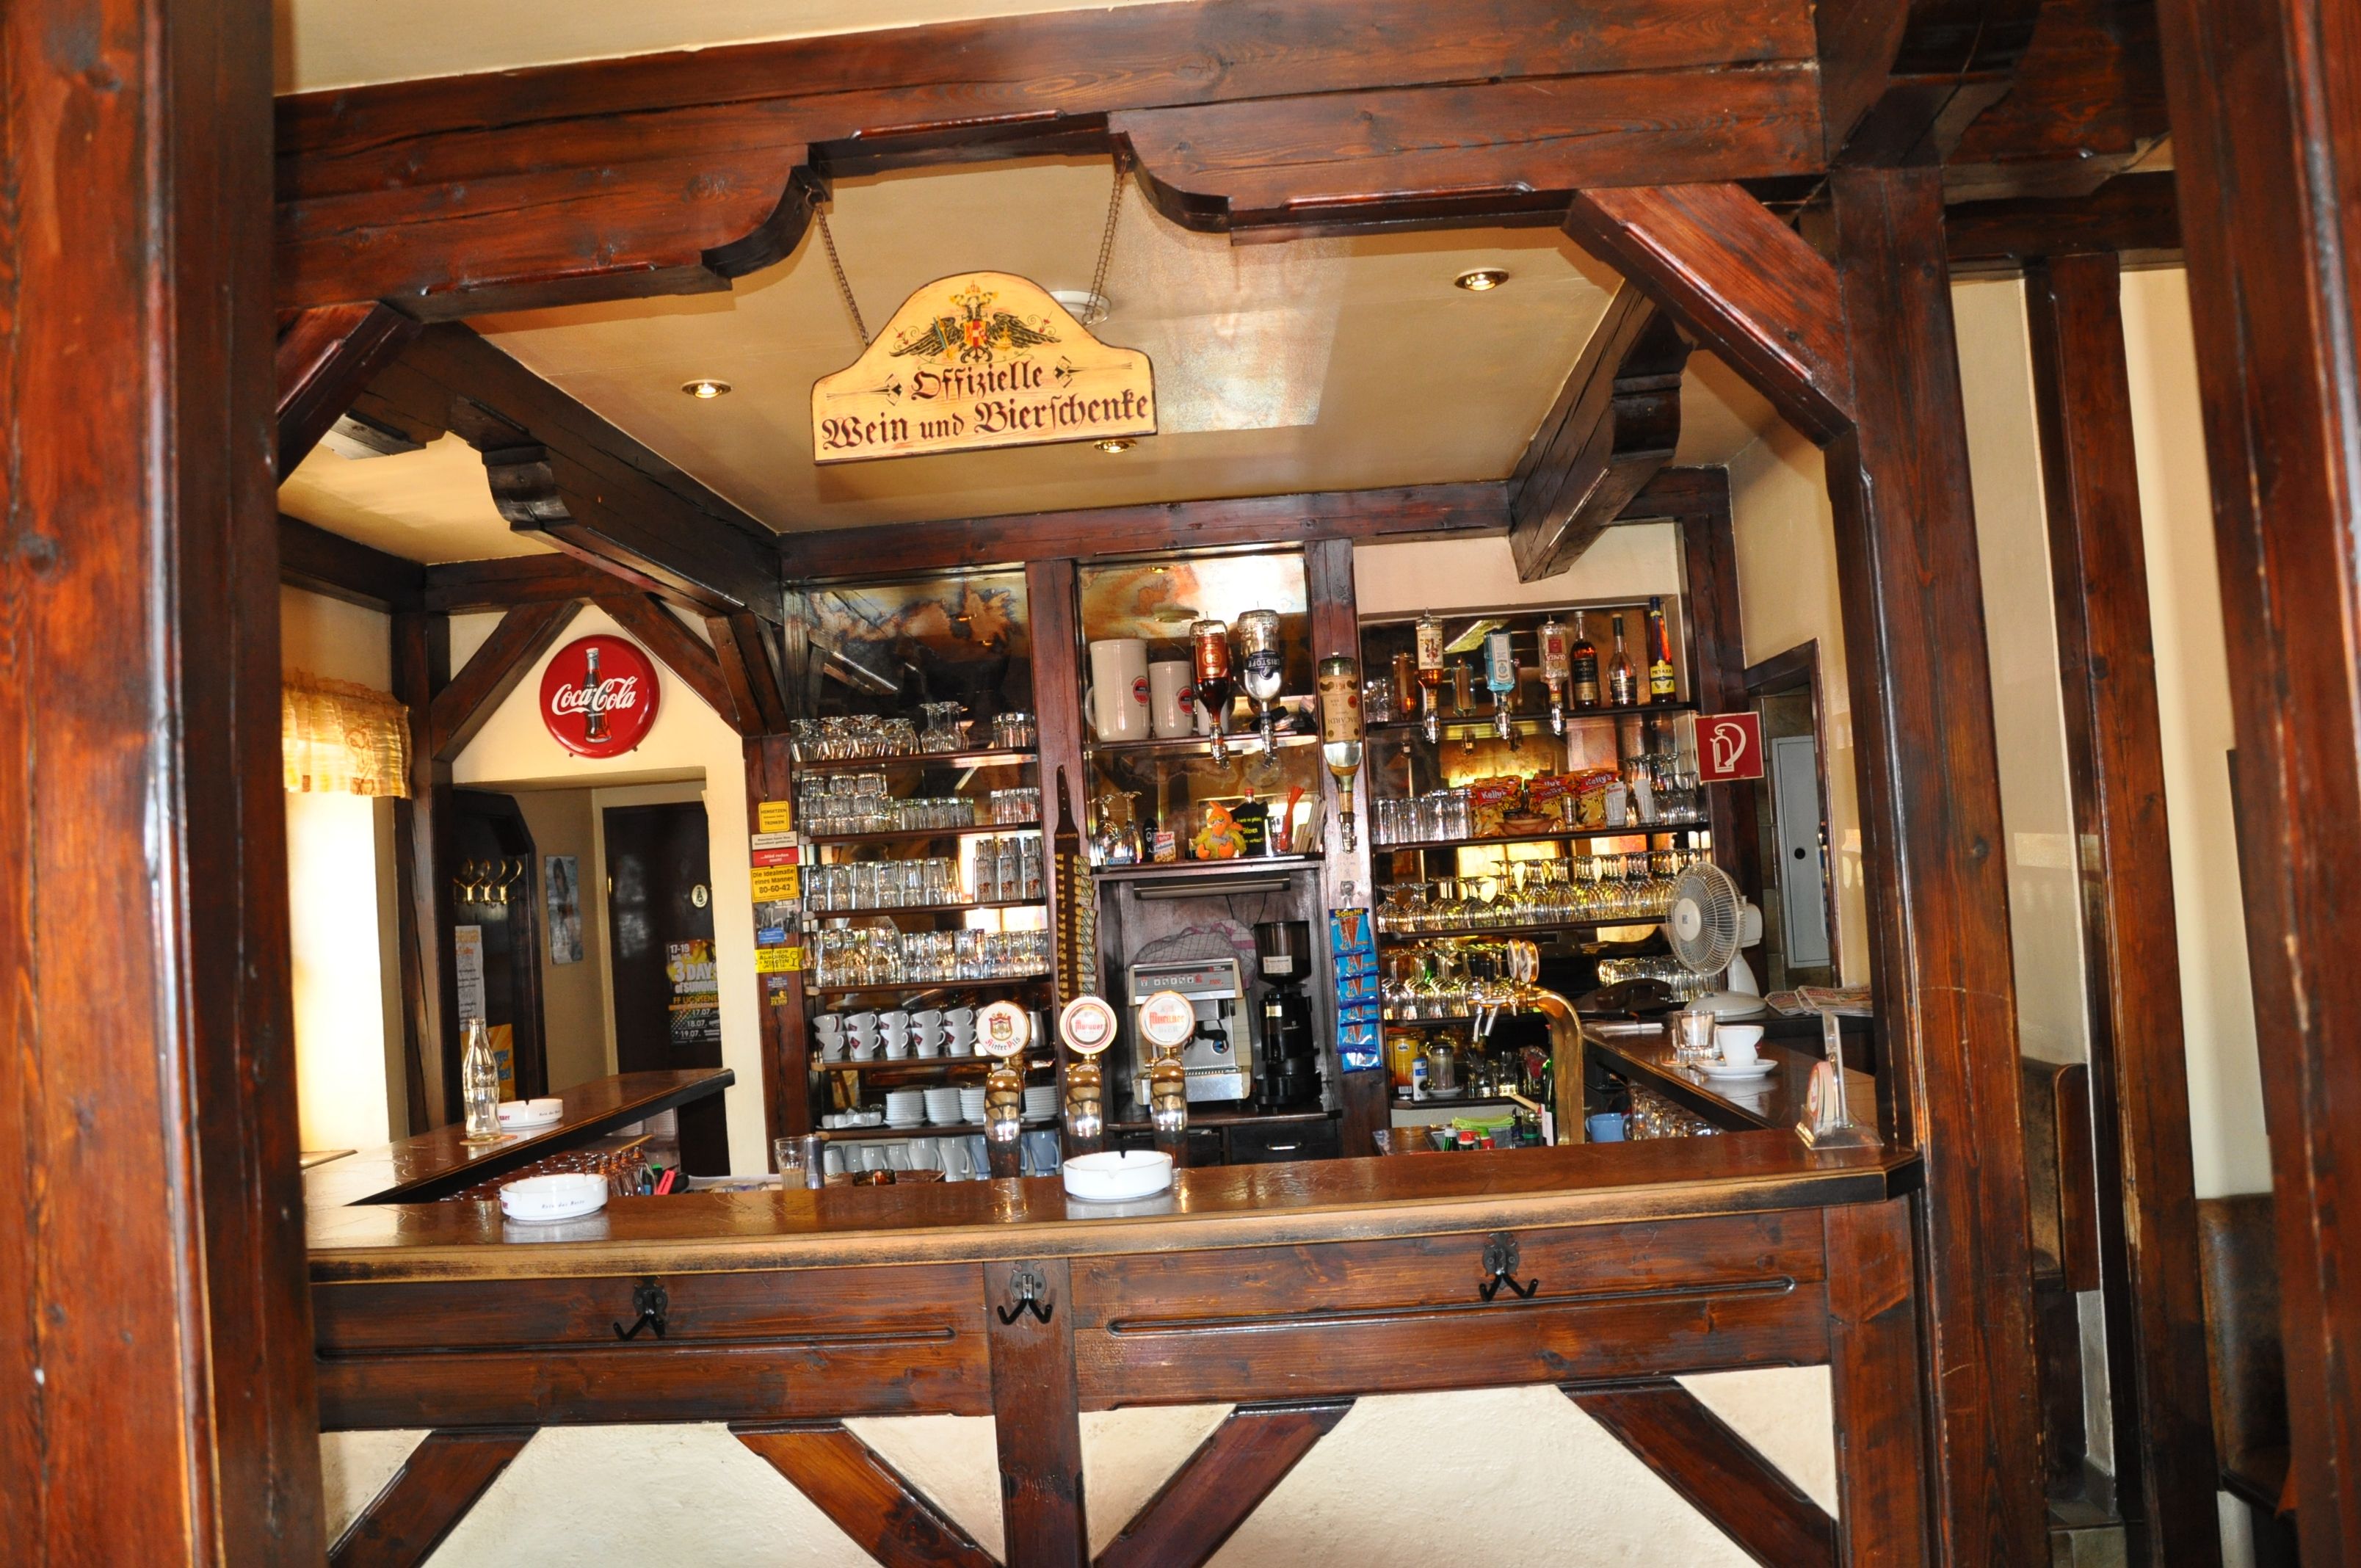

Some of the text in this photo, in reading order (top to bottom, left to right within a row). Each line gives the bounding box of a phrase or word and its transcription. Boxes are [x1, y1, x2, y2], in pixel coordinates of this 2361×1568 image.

[911, 360, 1042, 401] Offizielle
[822, 412, 908, 450] Wein
[920, 413, 964, 440] und
[551, 675, 638, 716] Coca-Cola
[1585, 774, 1612, 785] Kelly's
[758, 883, 791, 893] 80-60-42
[673, 961, 686, 982] 3
